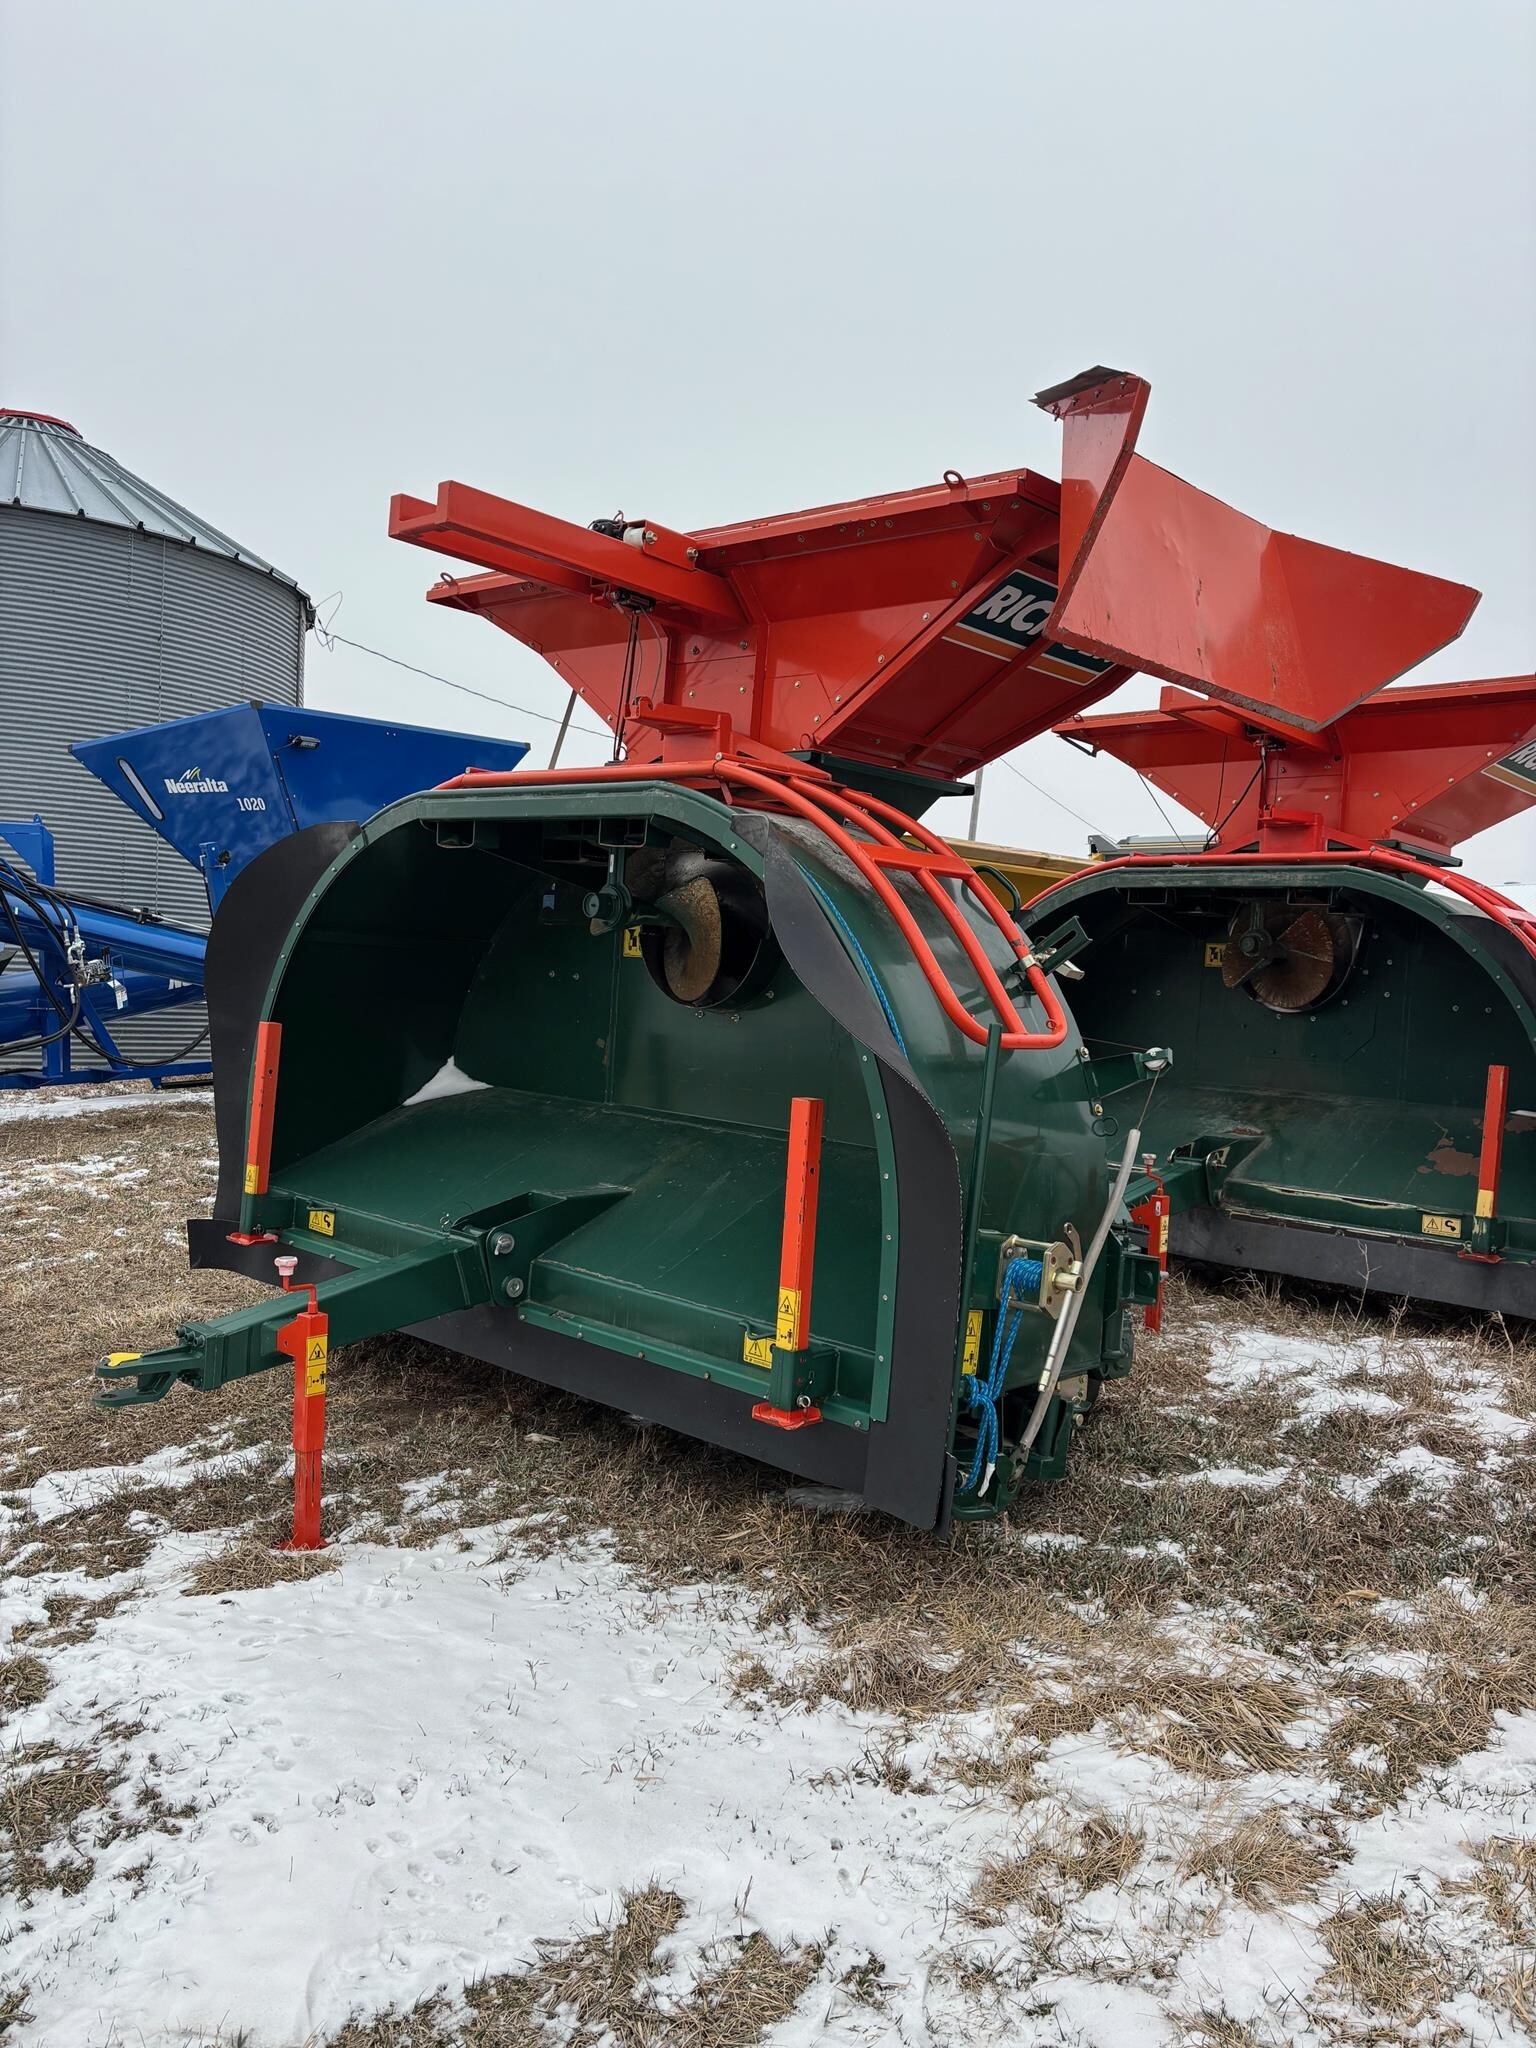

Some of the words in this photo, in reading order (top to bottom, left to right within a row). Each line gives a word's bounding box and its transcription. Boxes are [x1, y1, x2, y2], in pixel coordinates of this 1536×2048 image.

[972, 584, 1055, 636] RIC
[164, 777, 229, 794] Neeralta
[236, 797, 266, 812] 1020
